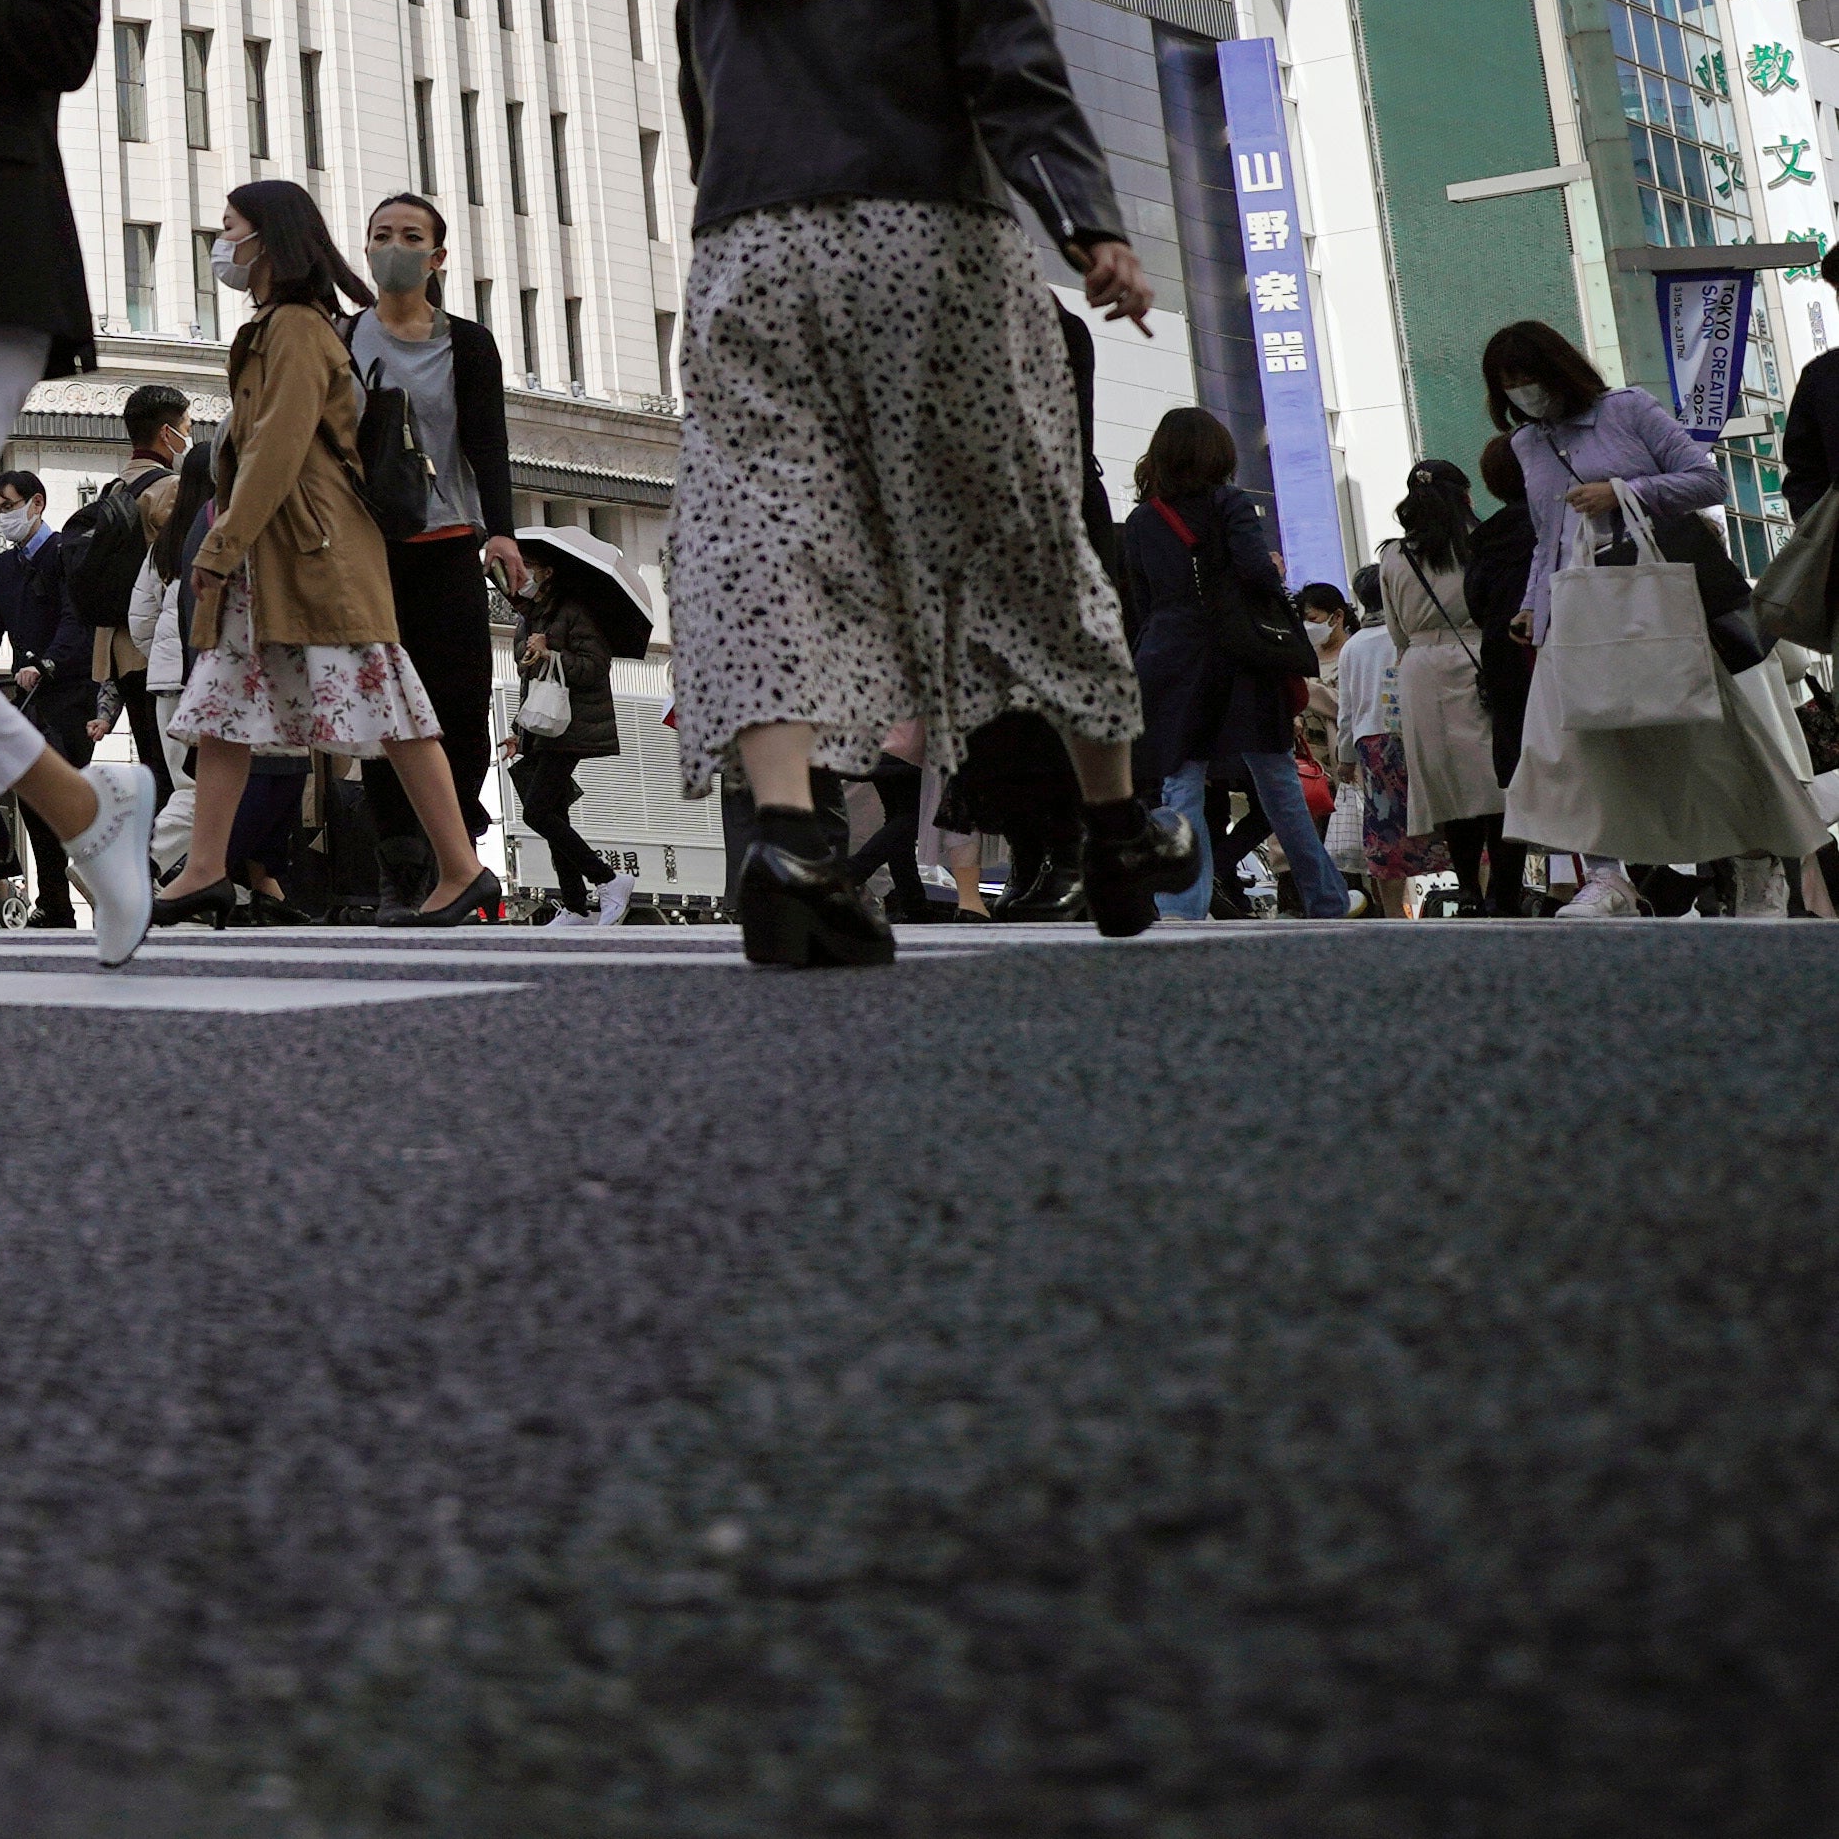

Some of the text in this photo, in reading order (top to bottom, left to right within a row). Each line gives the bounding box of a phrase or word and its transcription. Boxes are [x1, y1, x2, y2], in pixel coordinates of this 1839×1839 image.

[1238, 151, 1307, 373] 山野楽器
[1701, 285, 1718, 339] SALON
[1708, 284, 1735, 427] TOKYO CREATIVE
